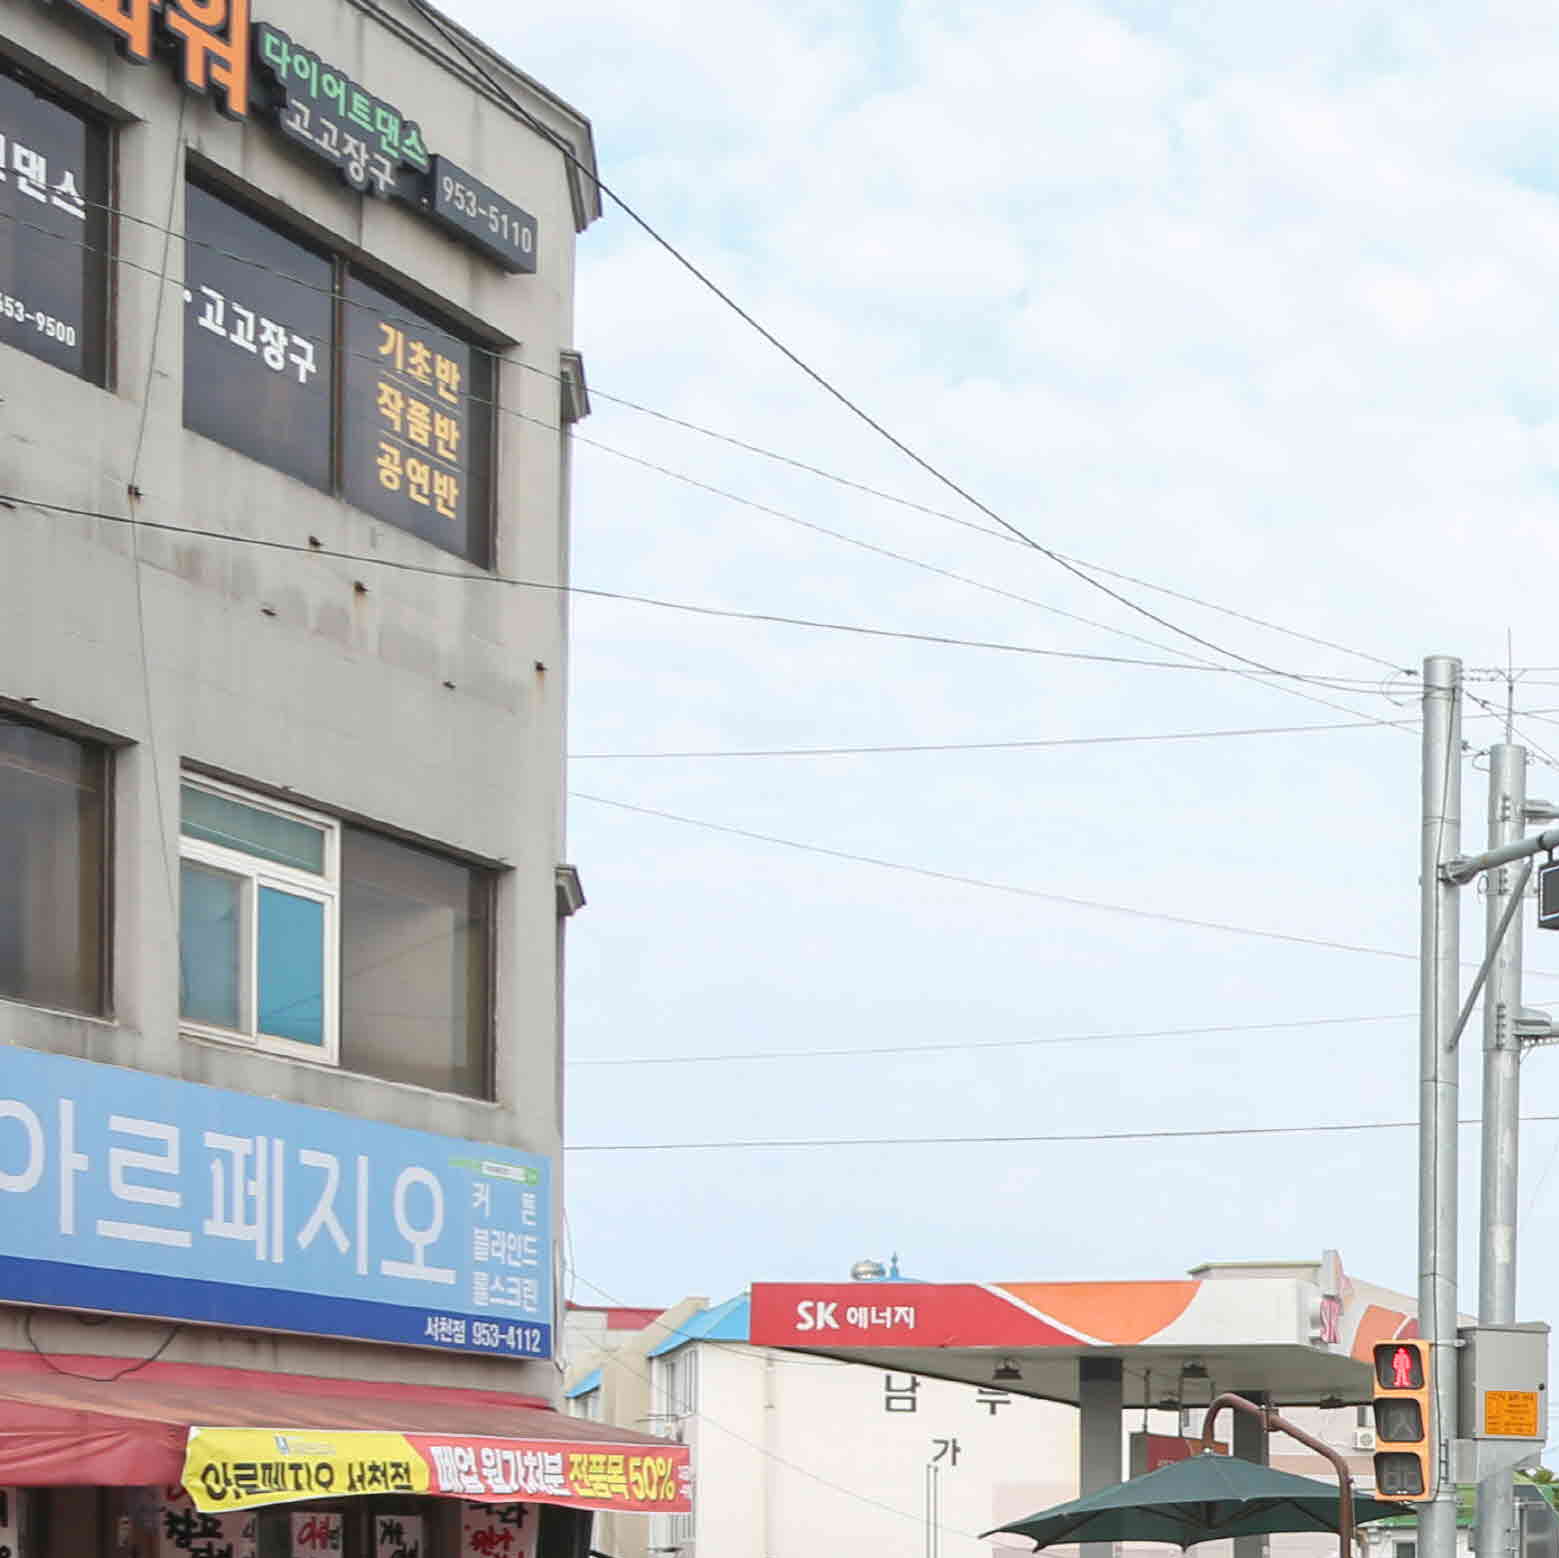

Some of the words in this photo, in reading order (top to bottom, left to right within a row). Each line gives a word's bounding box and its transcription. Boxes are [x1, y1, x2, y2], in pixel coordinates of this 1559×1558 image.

[263, 33, 429, 167] 다이어트댄스
[286, 99, 396, 191] 고고장구
[442, 176, 533, 254] 953-5110
[198, 285, 317, 384] 고고장구
[378, 321, 461, 404] 기초반
[376, 381, 460, 462] 작품반
[376, 441, 459, 519] 공연반
[0, 1098, 457, 1286] 아르페지오
[424, 1315, 467, 1345] 서천점
[472, 1320, 541, 1353] 953-4112
[796, 1300, 841, 1331] SK
[846, 1306, 916, 1330] 에너지
[626, 1456, 676, 1502] 50%
